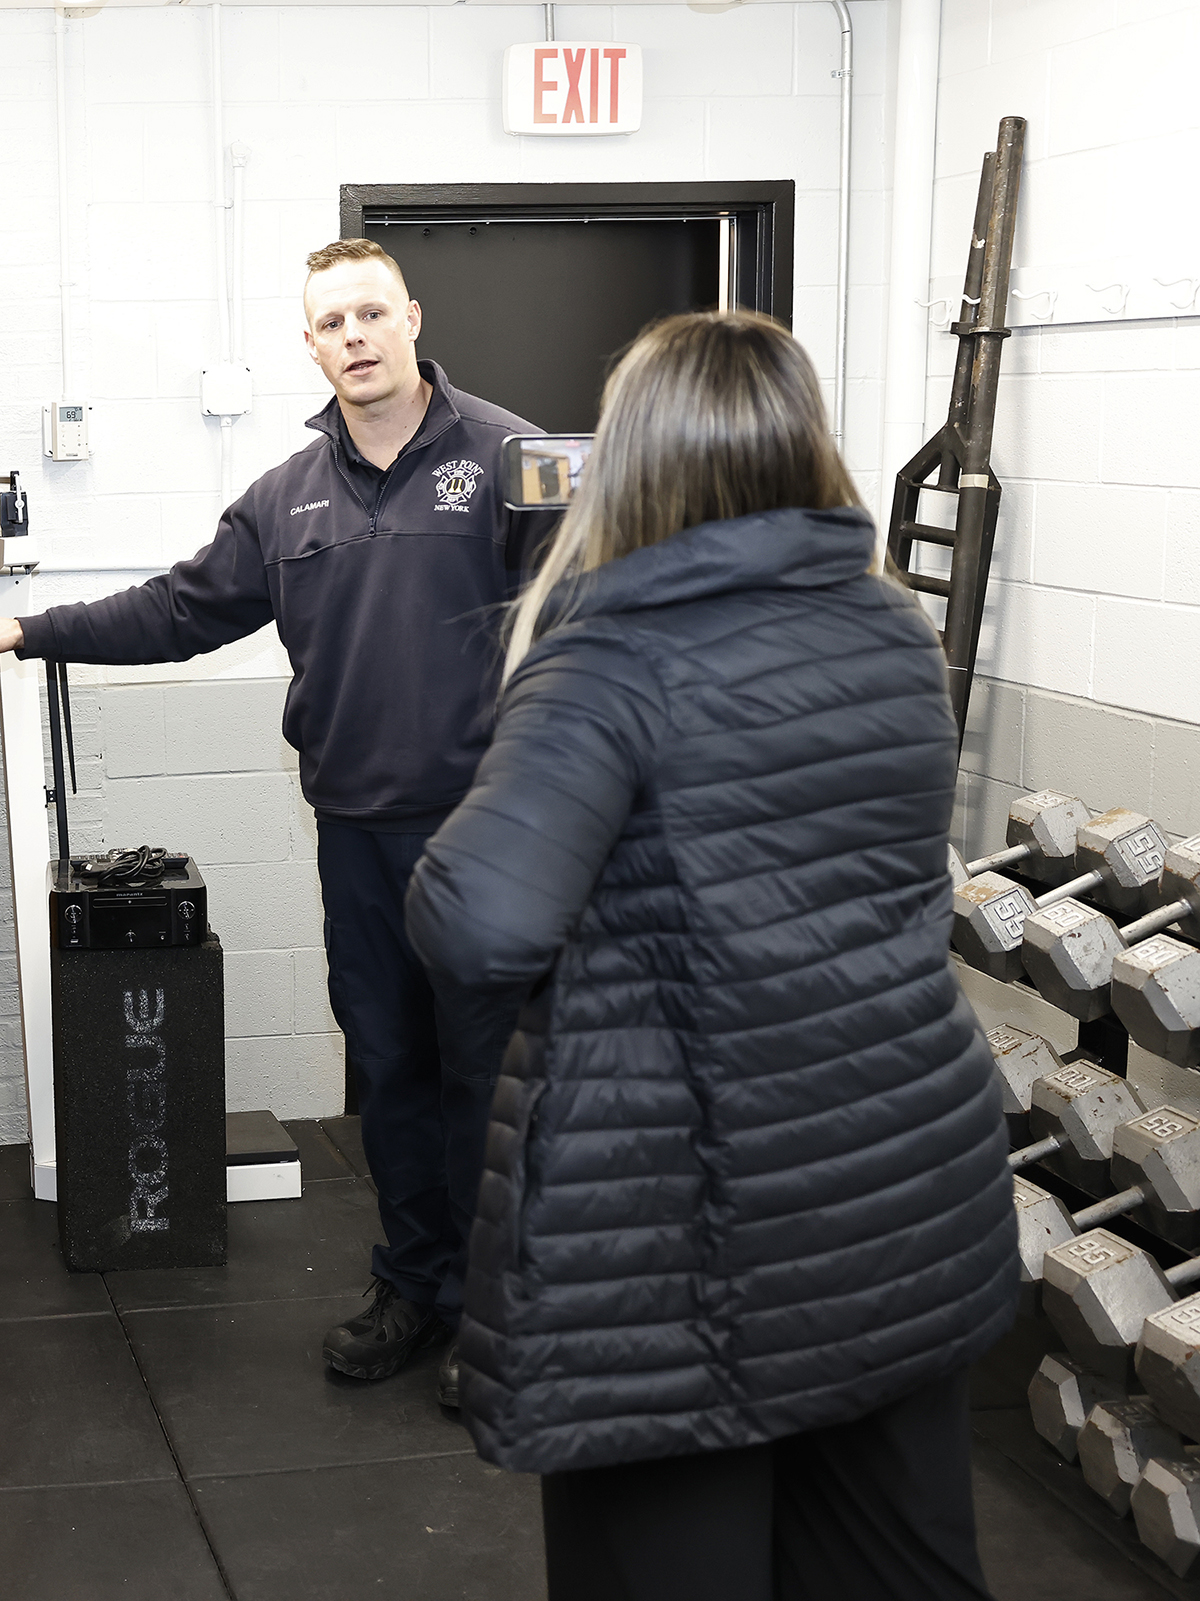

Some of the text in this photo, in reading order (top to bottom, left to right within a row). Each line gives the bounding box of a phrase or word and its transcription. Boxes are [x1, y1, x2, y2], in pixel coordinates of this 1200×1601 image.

[533, 48, 627, 124] EXIT
[66, 411, 76, 419] 69
[431, 459, 485, 478] WEST POINT
[290, 499, 330, 516] CALAMARI
[433, 504, 470, 513] NEW YORK
[1125, 832, 1165, 876] 55
[1041, 904, 1086, 928] 60
[1131, 942, 1181, 968] 60
[1053, 1067, 1099, 1092] 100
[122, 987, 171, 1234] ROGUE
[1139, 1116, 1184, 1138] 95
